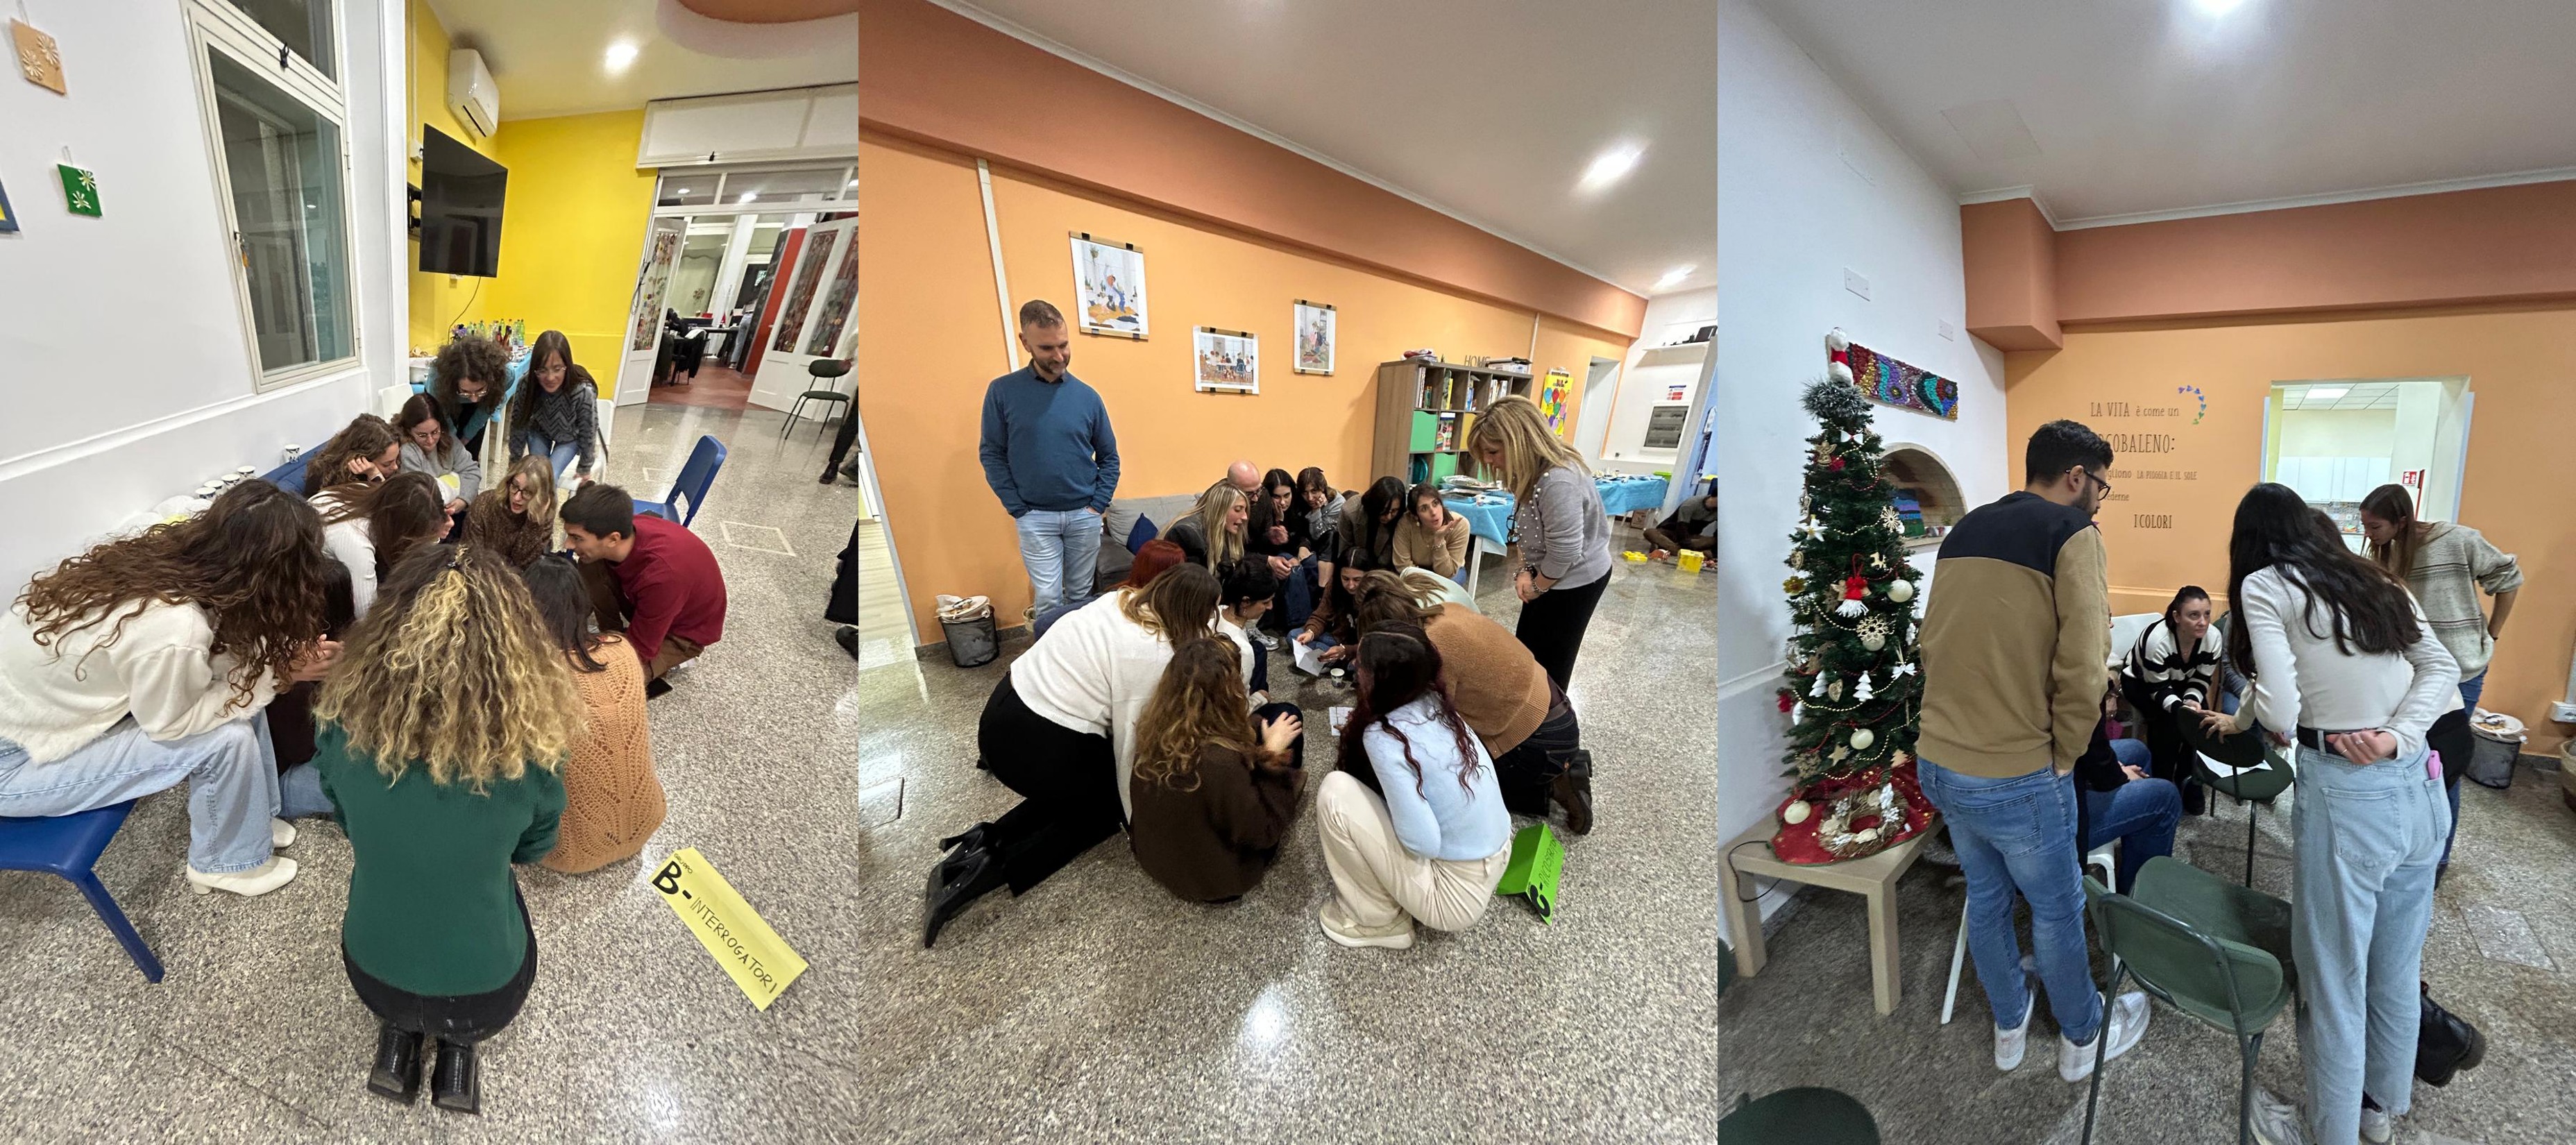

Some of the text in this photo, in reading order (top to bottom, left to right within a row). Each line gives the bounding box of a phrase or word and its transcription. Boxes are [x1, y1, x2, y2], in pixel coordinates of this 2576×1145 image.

[2091, 402, 2103, 417] LA
[2107, 402, 2130, 417] VITA
[2143, 407, 2164, 417] come
[2168, 407, 2179, 417] un
[2099, 434, 2175, 454] OBALENO:
[2107, 468, 2198, 480] gliono LA PIOGGIA E IL SOLE
[2106, 491, 2129, 501] ederne
[674, 853, 693, 874] GRUPPO
[690, 897, 777, 994] INTERROGATORI
